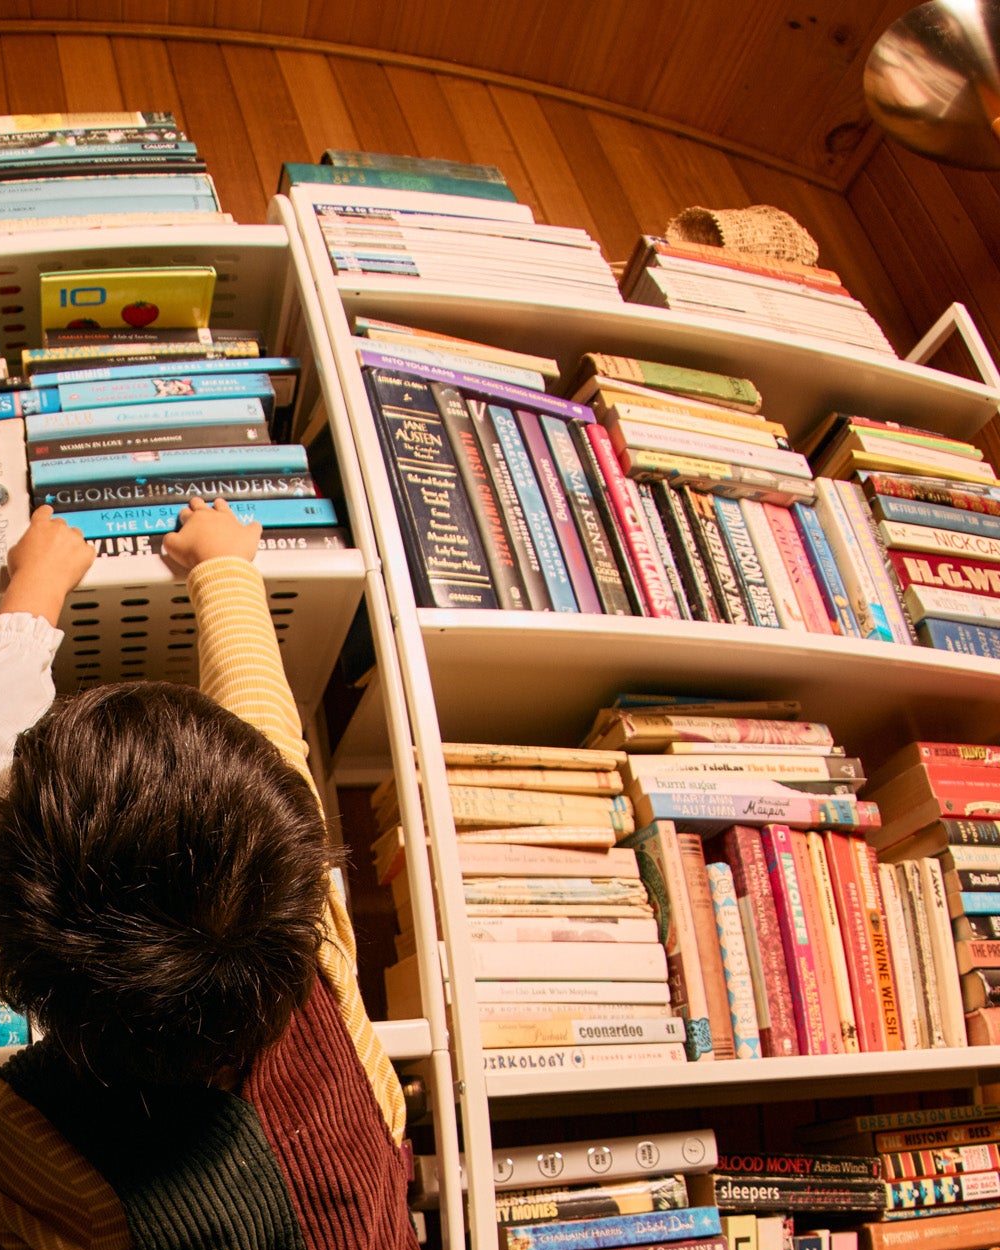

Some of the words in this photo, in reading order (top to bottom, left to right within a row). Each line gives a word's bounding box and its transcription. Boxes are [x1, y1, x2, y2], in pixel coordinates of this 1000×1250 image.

[381, 355, 404, 367] INTO
[405, 359, 431, 372] YOUR
[431, 365, 456, 379] ARMS
[402, 419, 428, 434] JANE
[395, 427, 444, 448] AUSTEN
[41, 458, 72, 468] MORAL
[74, 453, 128, 465] DISORDER
[56, 486, 145, 505] GEORGE
[173, 478, 290, 497] SAUNDERS
[459, 431, 488, 479] ALMOST
[476, 485, 515, 567] CHIMPANZEE
[553, 430, 592, 506] HANNAH
[580, 509, 608, 557] KENT
[100, 509, 153, 521] KARIN
[106, 521, 141, 532] THE
[932, 530, 976, 551] NICK
[655, 776, 687, 790] burnt
[688, 780, 717, 793] sugar
[672, 793, 706, 805] MARY
[707, 794, 734, 804] ANN
[743, 800, 786, 817] Maupin
[681, 804, 736, 817] AUTUMN
[930, 868, 944, 909] JAWS
[852, 899, 867, 947] EASTON
[861, 949, 873, 986] ELLIS
[872, 933, 891, 982] IRVINE
[881, 986, 899, 1036] WELSH
[578, 1023, 644, 1039] coonardoo
[859, 1115, 894, 1131] BRET
[897, 1110, 948, 1126] EASTON
[951, 1105, 984, 1122] ELLIS
[882, 1136, 902, 1149] THE
[904, 1131, 950, 1146] HISTORY
[968, 1126, 991, 1139] BEES
[717, 1154, 765, 1173] BLOOD
[766, 1157, 813, 1174] MONEY
[813, 1159, 842, 1173] Arden
[843, 1161, 868, 1174] Winch
[721, 1182, 781, 1202] sleepers
[512, 1202, 559, 1222] MOVIES
[539, 1230, 591, 1244] CHARLAINE
[591, 1226, 624, 1238] HARRIS
